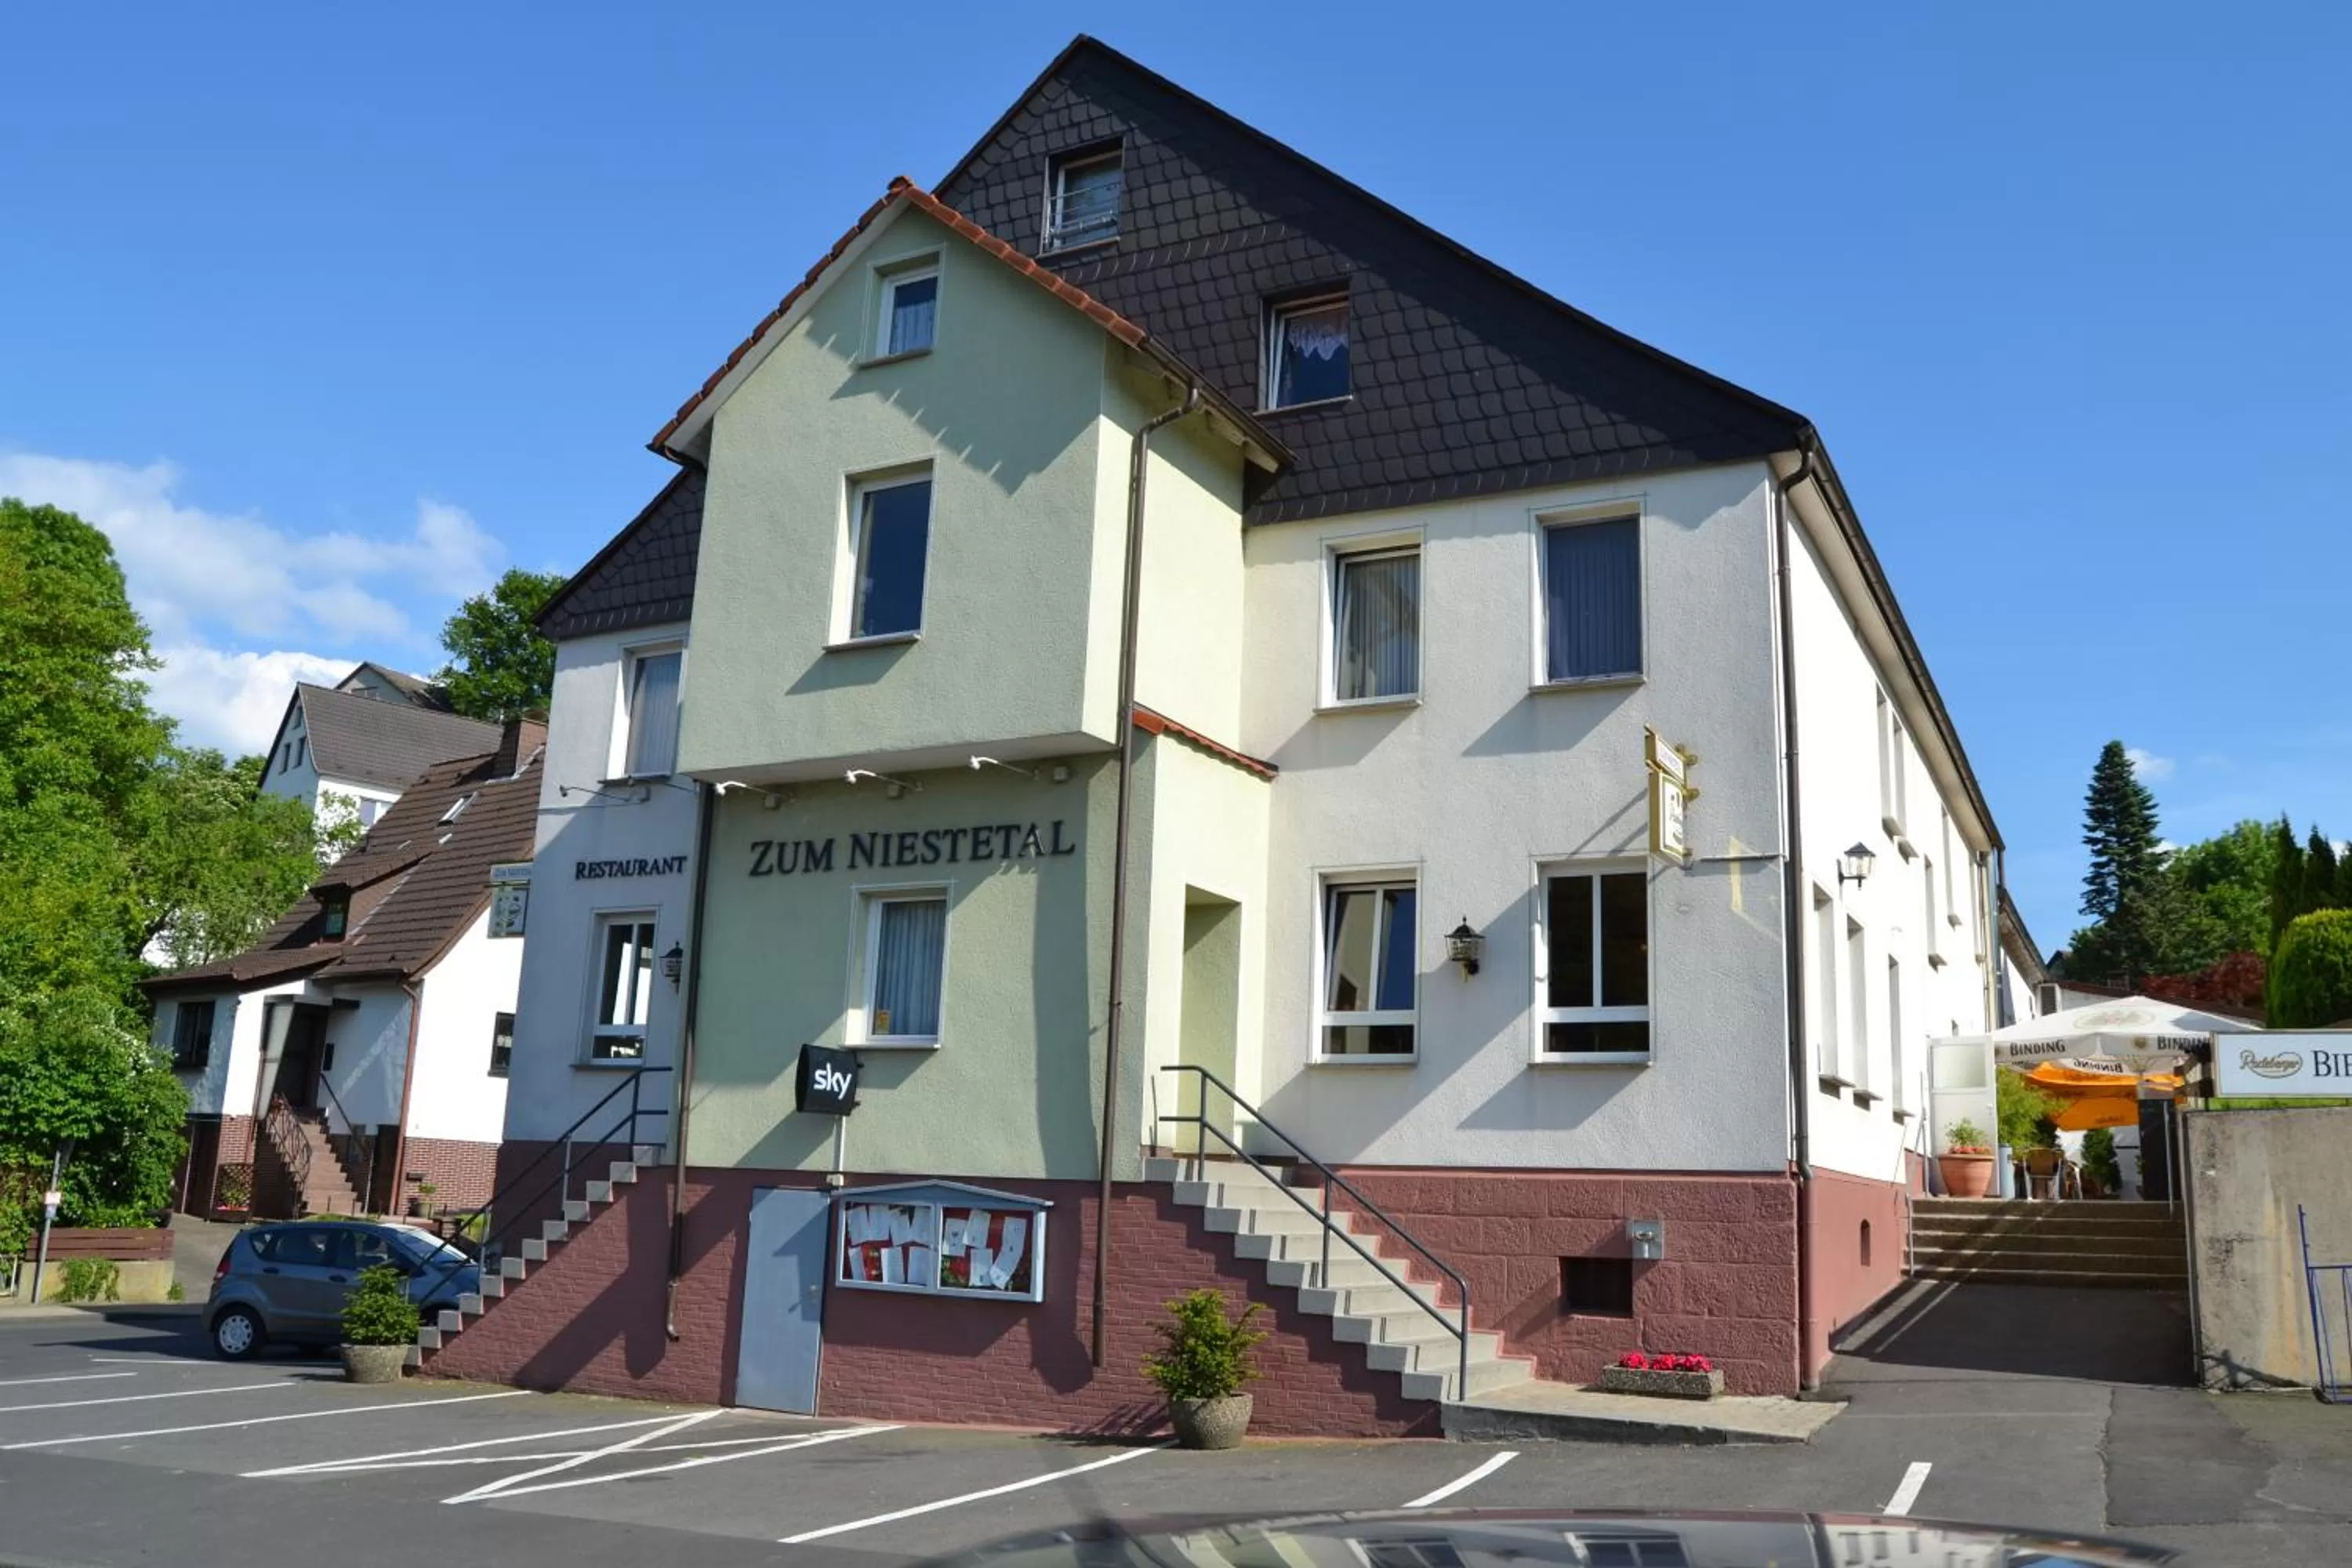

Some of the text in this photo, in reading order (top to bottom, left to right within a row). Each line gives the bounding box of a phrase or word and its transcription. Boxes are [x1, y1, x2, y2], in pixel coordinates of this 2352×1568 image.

[749, 819, 1076, 877] ZUM NIESTETAL
[575, 855, 688, 880] RESTAURANT
[2010, 1039, 2066, 1057] BINDING
[814, 1062, 852, 1101] sky
